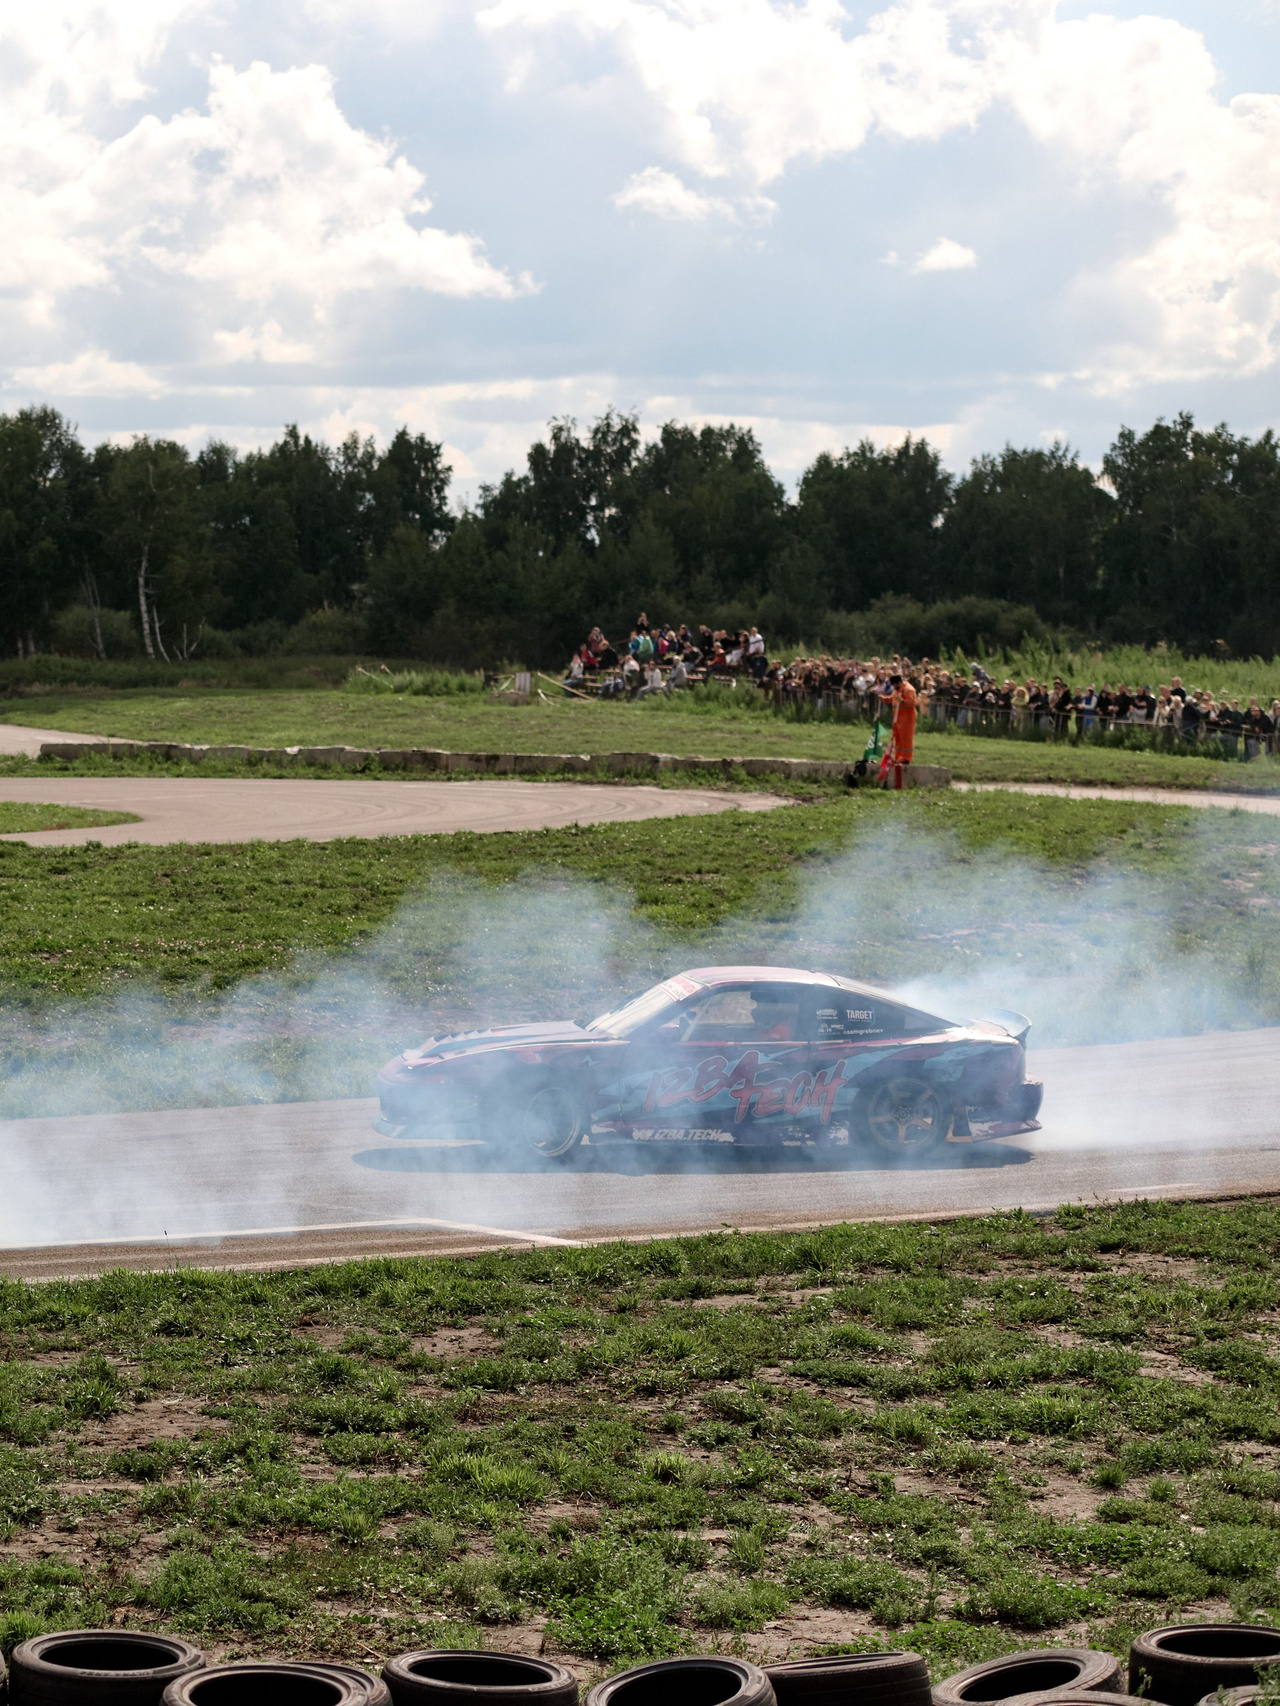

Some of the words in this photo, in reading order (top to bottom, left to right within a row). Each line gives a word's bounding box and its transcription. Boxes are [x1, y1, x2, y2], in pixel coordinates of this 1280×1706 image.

[846, 1009, 873, 1020] TARGET
[643, 1049, 782, 1113] IZBA
[730, 1059, 848, 1125] TECH
